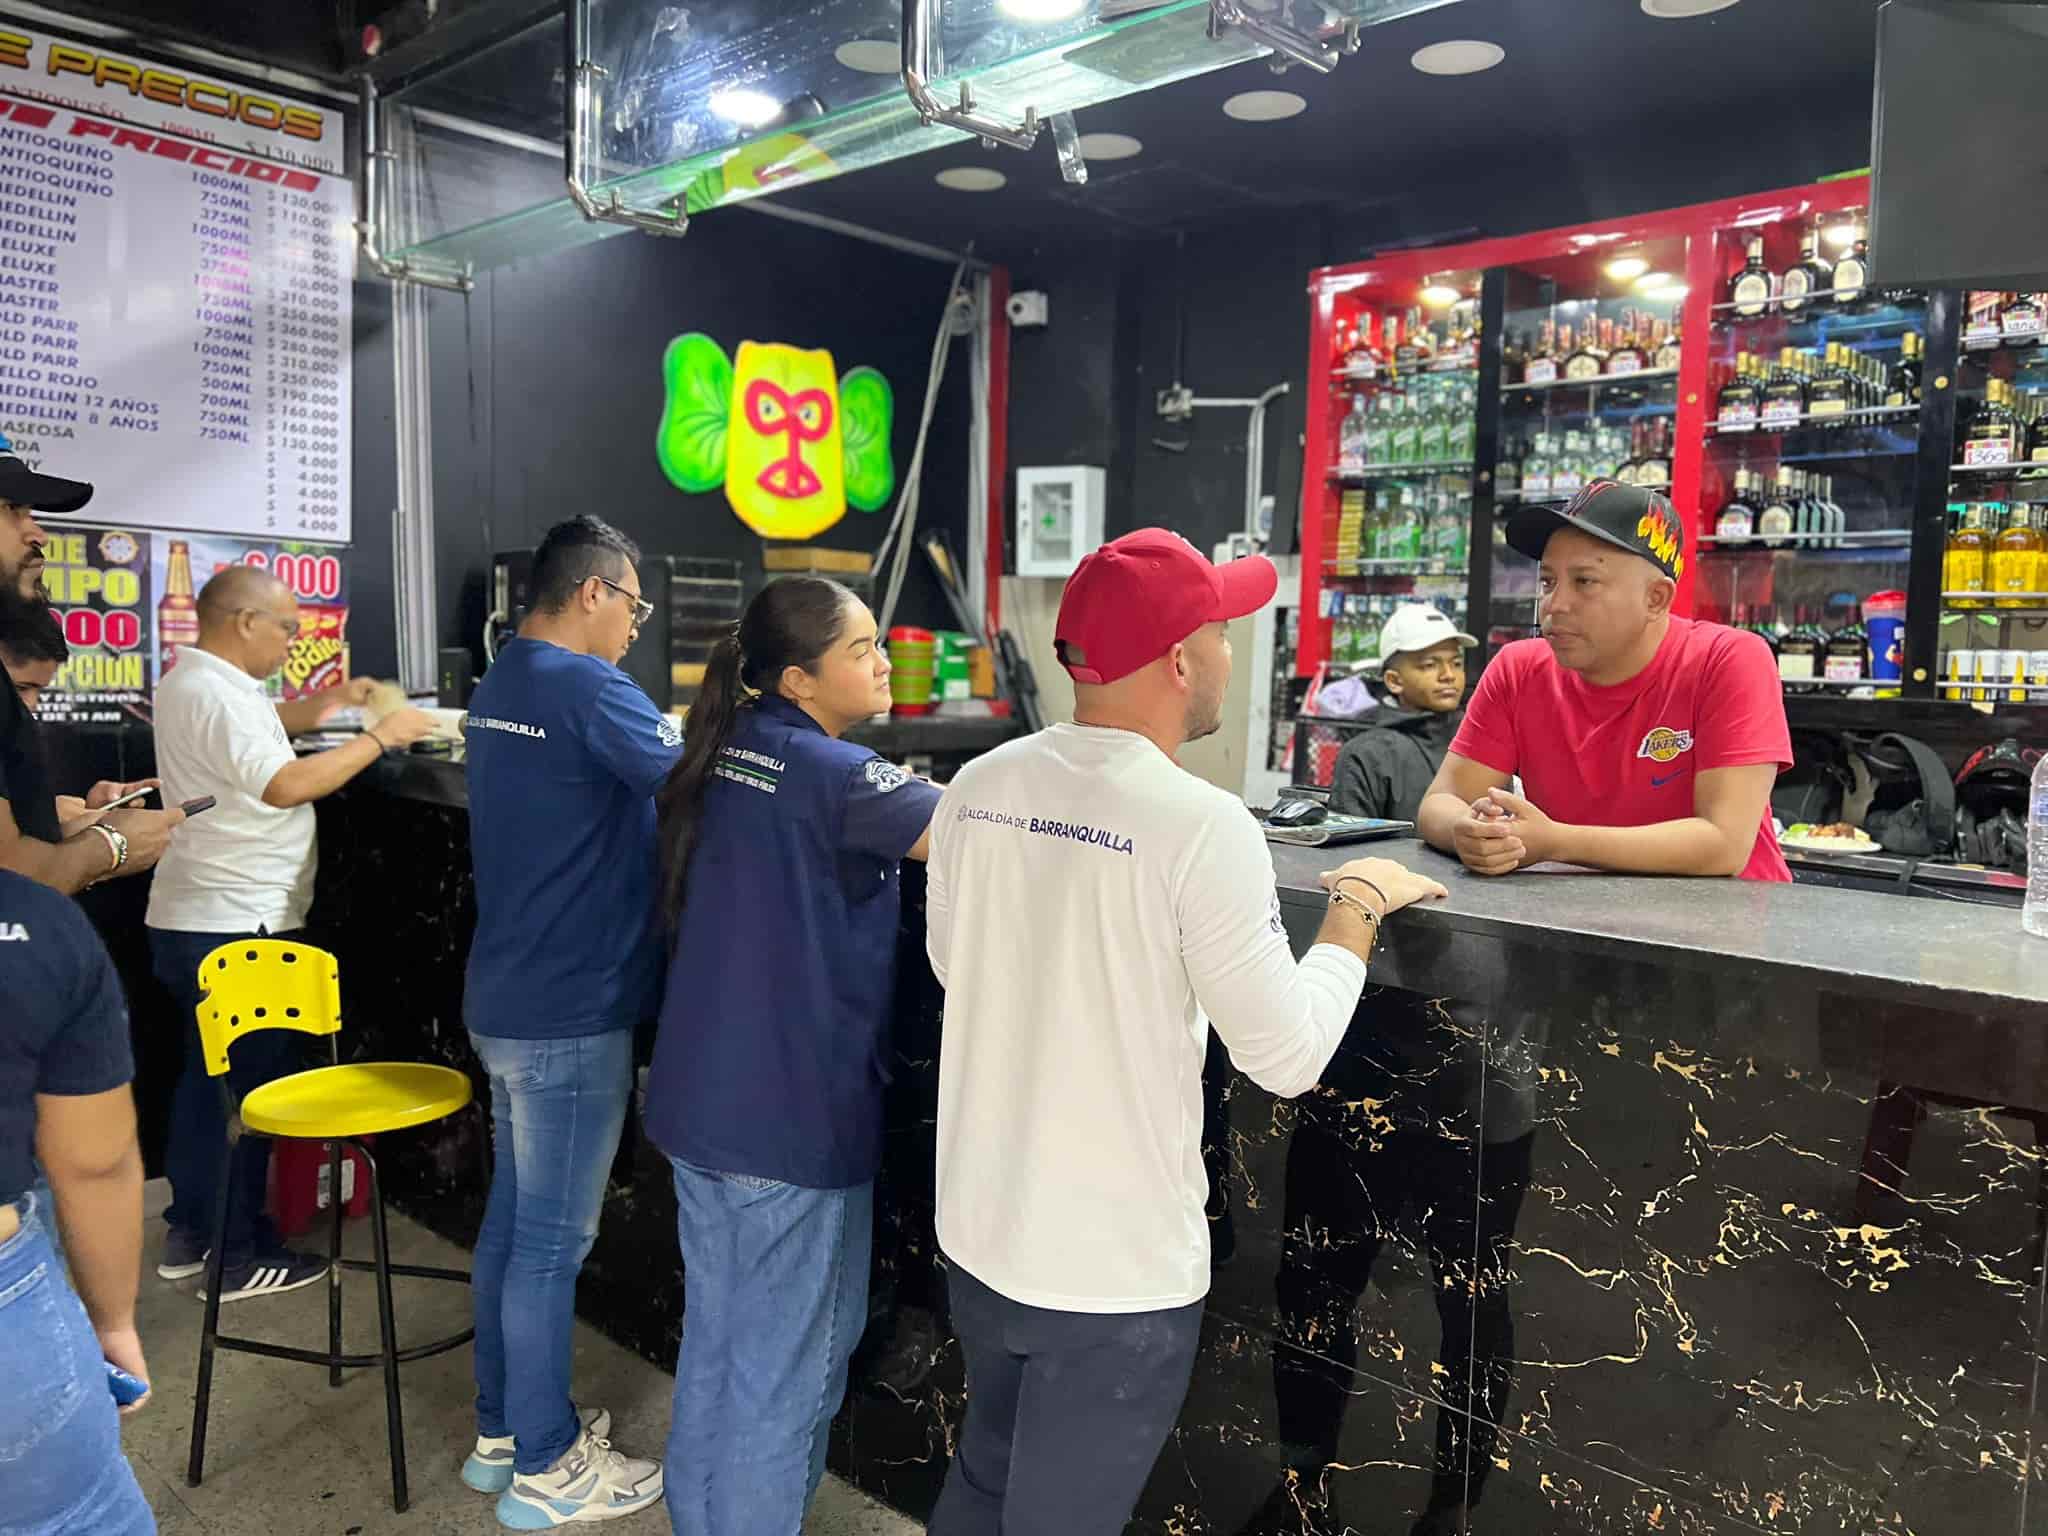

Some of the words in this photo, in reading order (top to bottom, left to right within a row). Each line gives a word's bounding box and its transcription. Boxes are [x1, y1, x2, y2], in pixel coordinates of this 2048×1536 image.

[47, 44, 323, 142] PRECIOS
[0, 182, 76, 206] EDELLIN
[192, 171, 251, 194] 1000ML
[0, 200, 76, 224] EDELLIN
[201, 190, 250, 211] 750ML
[0, 218, 76, 243] EDELLIN
[0, 274, 59, 292] ASTER
[196, 309, 253, 328] 1000ML
[0, 292, 59, 310] ASTER
[204, 327, 253, 344] 750ML
[0, 311, 25, 325] LD
[32, 314, 78, 333] PARR
[193, 341, 251, 360] 1000ML
[0, 329, 25, 343] LD
[32, 333, 78, 351] PARR
[201, 360, 251, 377] 750ML
[0, 347, 25, 361] LD
[32, 351, 78, 368] PARR
[201, 377, 251, 394] 500ML
[0, 383, 77, 404] EDELLIN
[85, 394, 104, 408] 12
[200, 410, 249, 426] 750ML
[48, 371, 98, 389] ROJO
[200, 394, 250, 409] 700ML
[0, 402, 77, 421] EDELLIN
[200, 427, 249, 443] 750ML
[298, 456, 338, 469] 4.000
[298, 472, 338, 485] 4.000
[298, 488, 338, 501] 4.000
[298, 503, 338, 516] 4.000
[298, 519, 338, 532] 4.000
[44, 534, 86, 564] DE
[48, 608, 141, 650] 00
[91, 712, 122, 722] AM
[967, 808, 1013, 826] ALCALDÍA
[1014, 819, 1028, 829] DE
[1029, 818, 1133, 855] BARRANQUILLA
